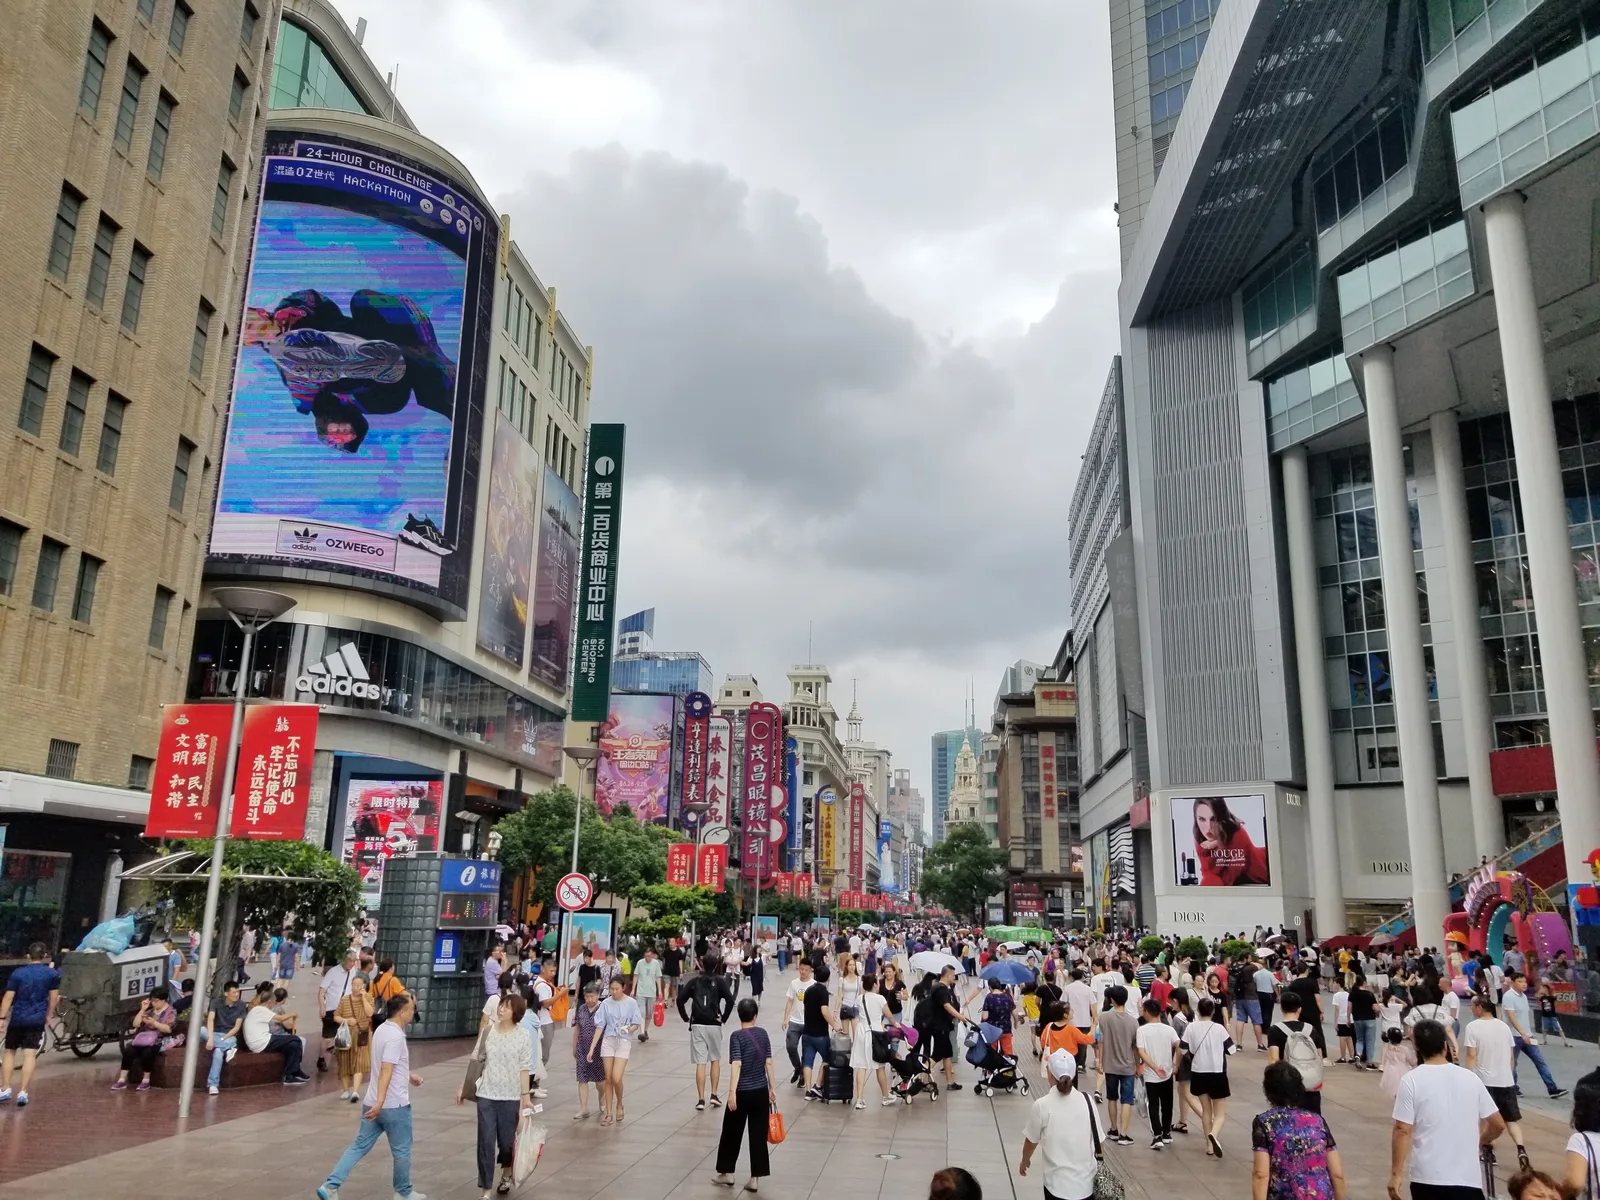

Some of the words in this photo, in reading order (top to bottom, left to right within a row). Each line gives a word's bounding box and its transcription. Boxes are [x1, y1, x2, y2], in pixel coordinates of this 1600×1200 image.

[306, 147, 363, 167] 24-HOUR
[369, 160, 433, 193] CHALLENGE
[343, 174, 411, 203] HACKATHON
[291, 543, 317, 552] adidas
[325, 537, 385, 558] OZWEEGO
[586, 482, 612, 621] 第一百货商业中心
[580, 638, 590, 674] CENTER
[587, 638, 598, 684] SHOPPING
[597, 638, 605, 658] NO.1
[295, 672, 381, 701] adidas
[262, 745, 285, 815] 牢记使命
[279, 736, 301, 805] 不忘初心
[245, 754, 268, 825] 永远奋斗
[370, 797, 420, 809] 限时特惠
[746, 744, 769, 857] 茂昌眼镜公司
[1210, 848, 1245, 858] ROUGE
[1372, 861, 1410, 873] DIOR
[1173, 911, 1206, 923] DIOR
